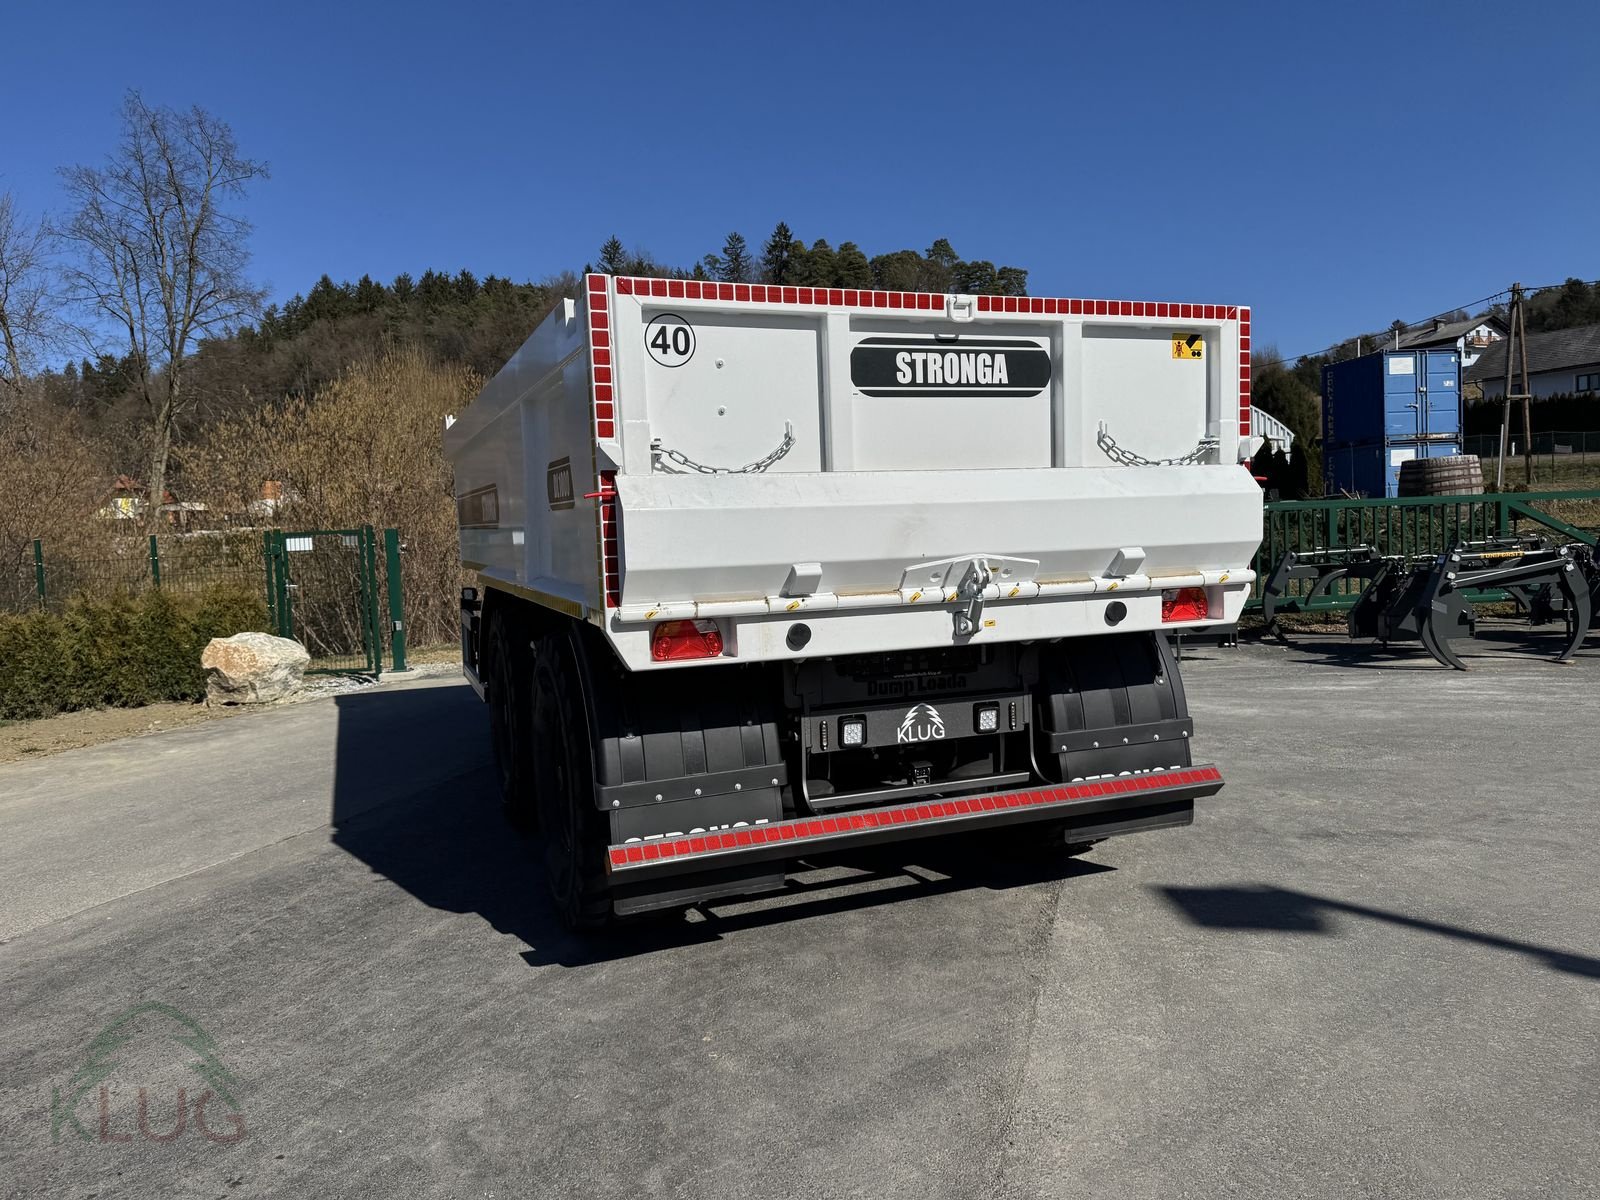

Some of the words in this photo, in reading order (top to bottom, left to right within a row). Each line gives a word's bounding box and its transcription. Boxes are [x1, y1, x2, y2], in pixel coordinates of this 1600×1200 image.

[651, 325, 690, 356] 40
[895, 351, 1009, 385] STRONGA
[867, 679, 914, 697] Dump
[897, 723, 945, 743] KLUG
